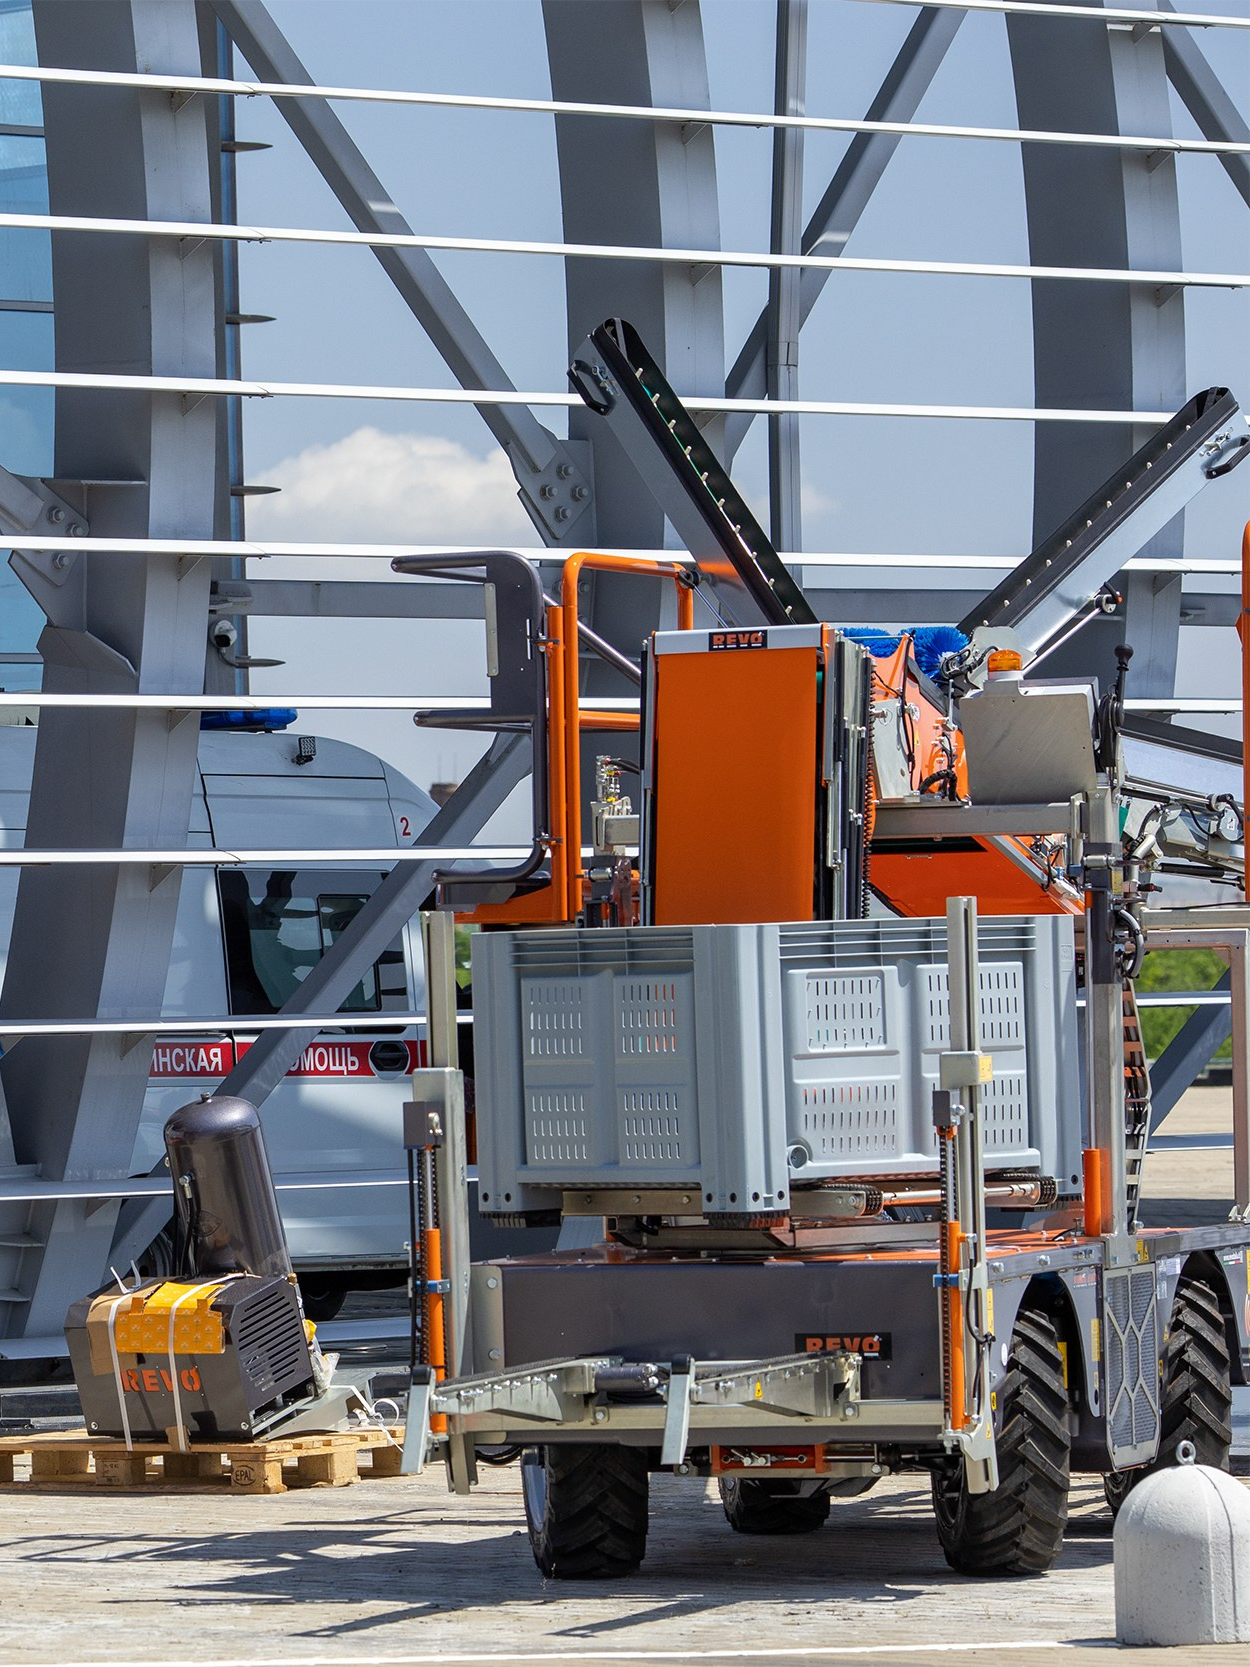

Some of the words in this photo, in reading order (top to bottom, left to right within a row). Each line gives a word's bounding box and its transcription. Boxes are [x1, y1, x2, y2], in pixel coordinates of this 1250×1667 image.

[712, 633, 763, 646] REVO
[400, 816, 411, 837] 2
[290, 1047, 359, 1076] МОЩЬ
[805, 1336, 881, 1353] REVO
[120, 1366, 202, 1392] REVO
[235, 1469, 254, 1482] EPAL
